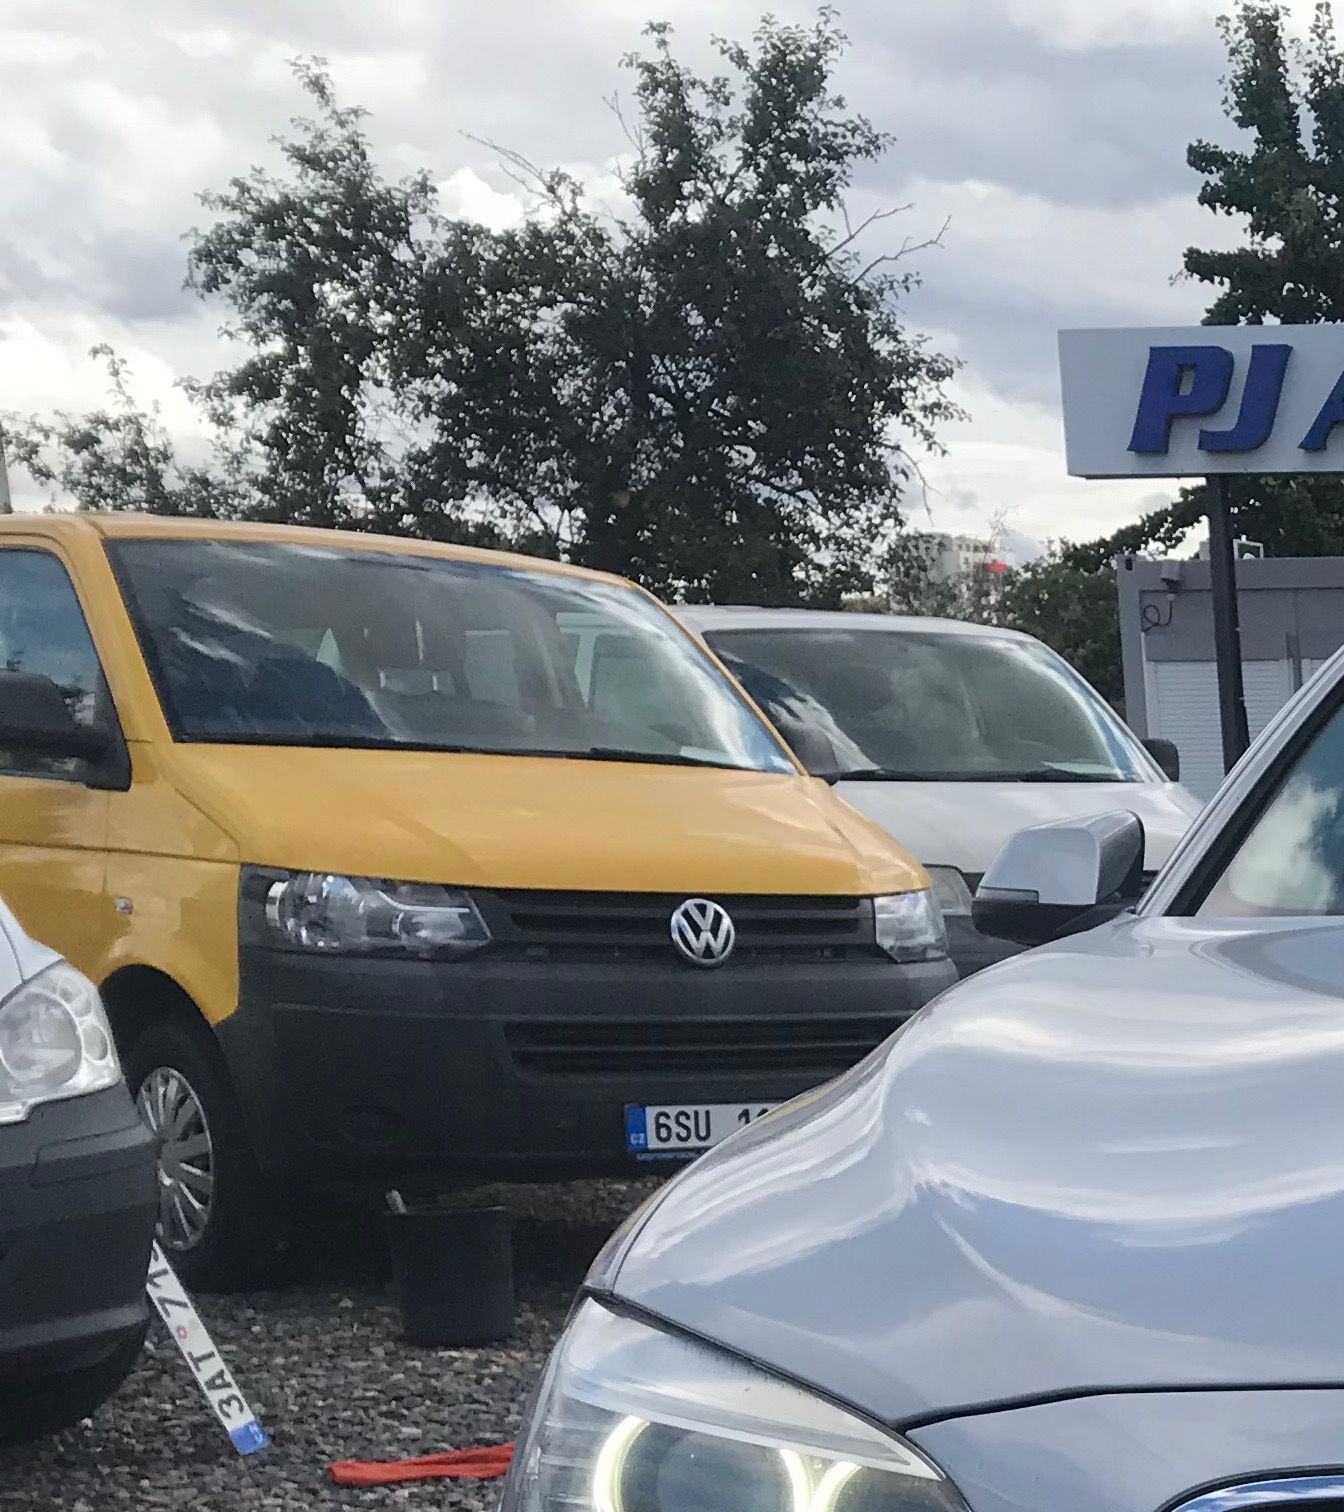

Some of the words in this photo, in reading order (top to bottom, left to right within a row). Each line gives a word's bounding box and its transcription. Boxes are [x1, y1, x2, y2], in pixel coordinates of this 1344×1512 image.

[1126, 343, 1294, 455] PJ
[654, 1110, 711, 1143] 6SU
[187, 1351, 244, 1420] 3AT
